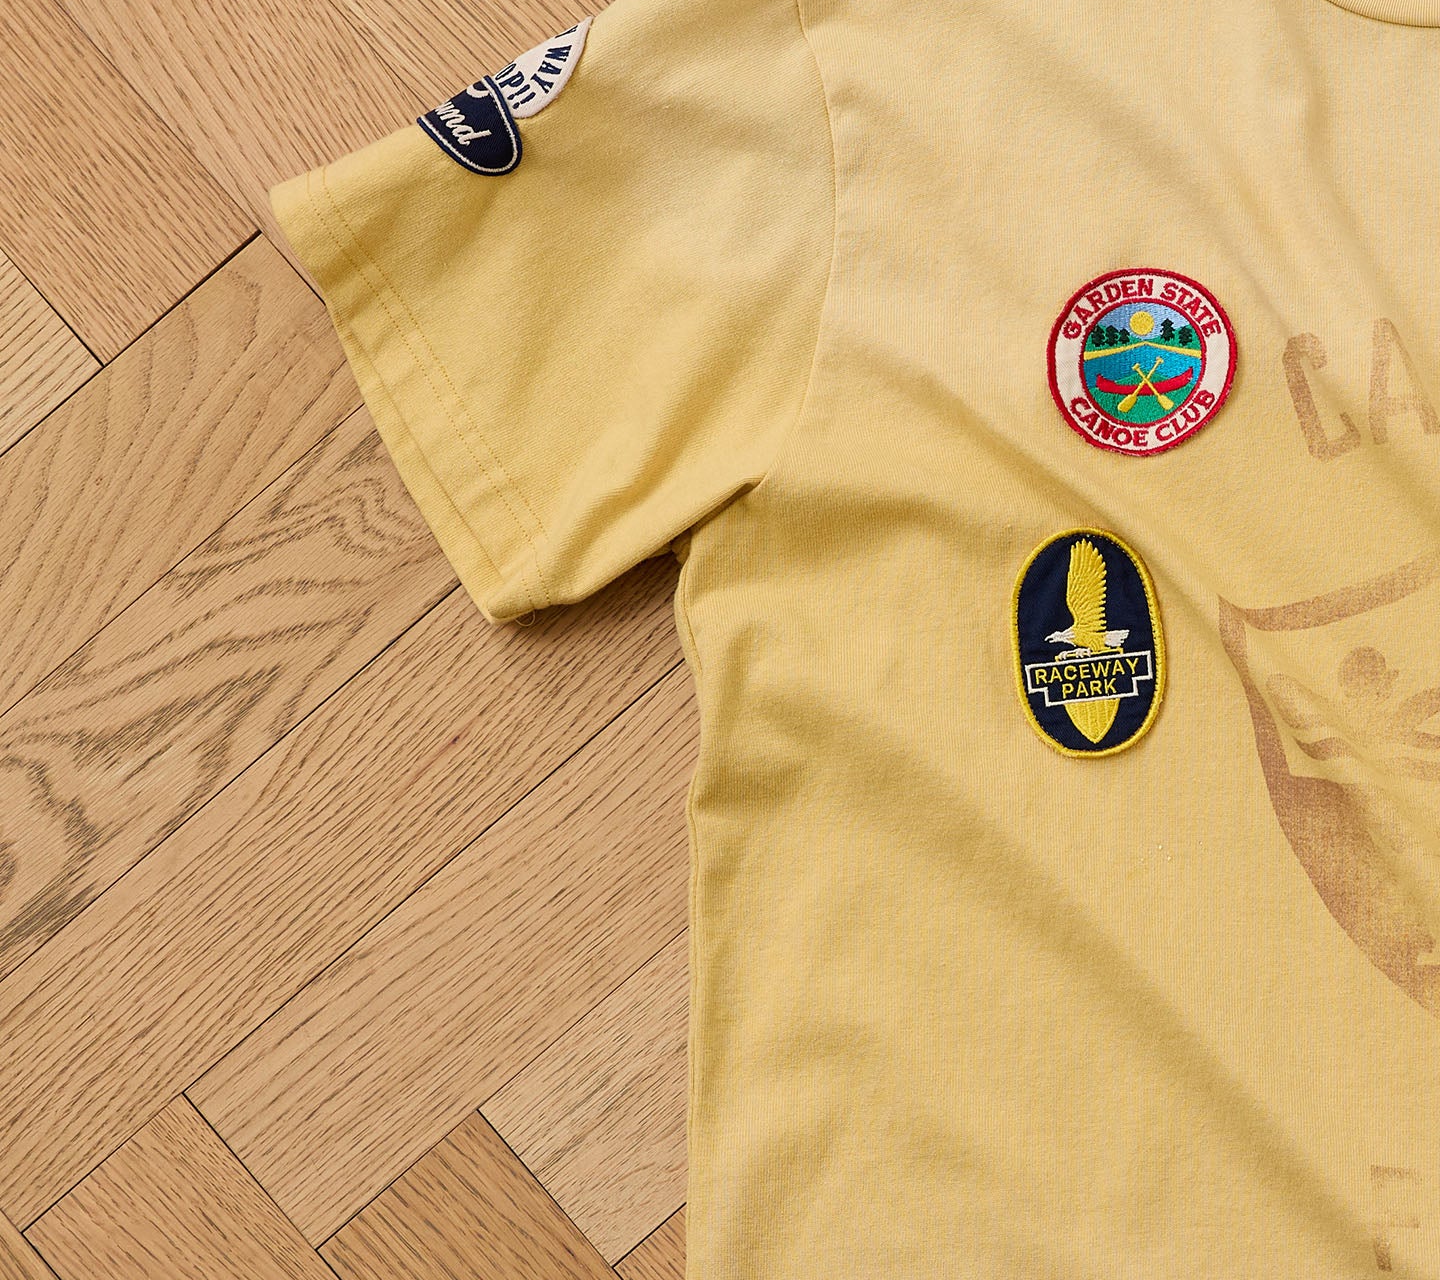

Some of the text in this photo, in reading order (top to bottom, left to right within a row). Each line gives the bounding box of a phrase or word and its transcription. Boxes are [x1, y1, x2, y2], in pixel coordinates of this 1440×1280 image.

[1062, 278, 1222, 339] GARDEN STATE
[1069, 389, 1216, 447] CANOE CLUB
[1034, 657, 1139, 685] RACEWAY
[1061, 677, 1118, 699] PARK
